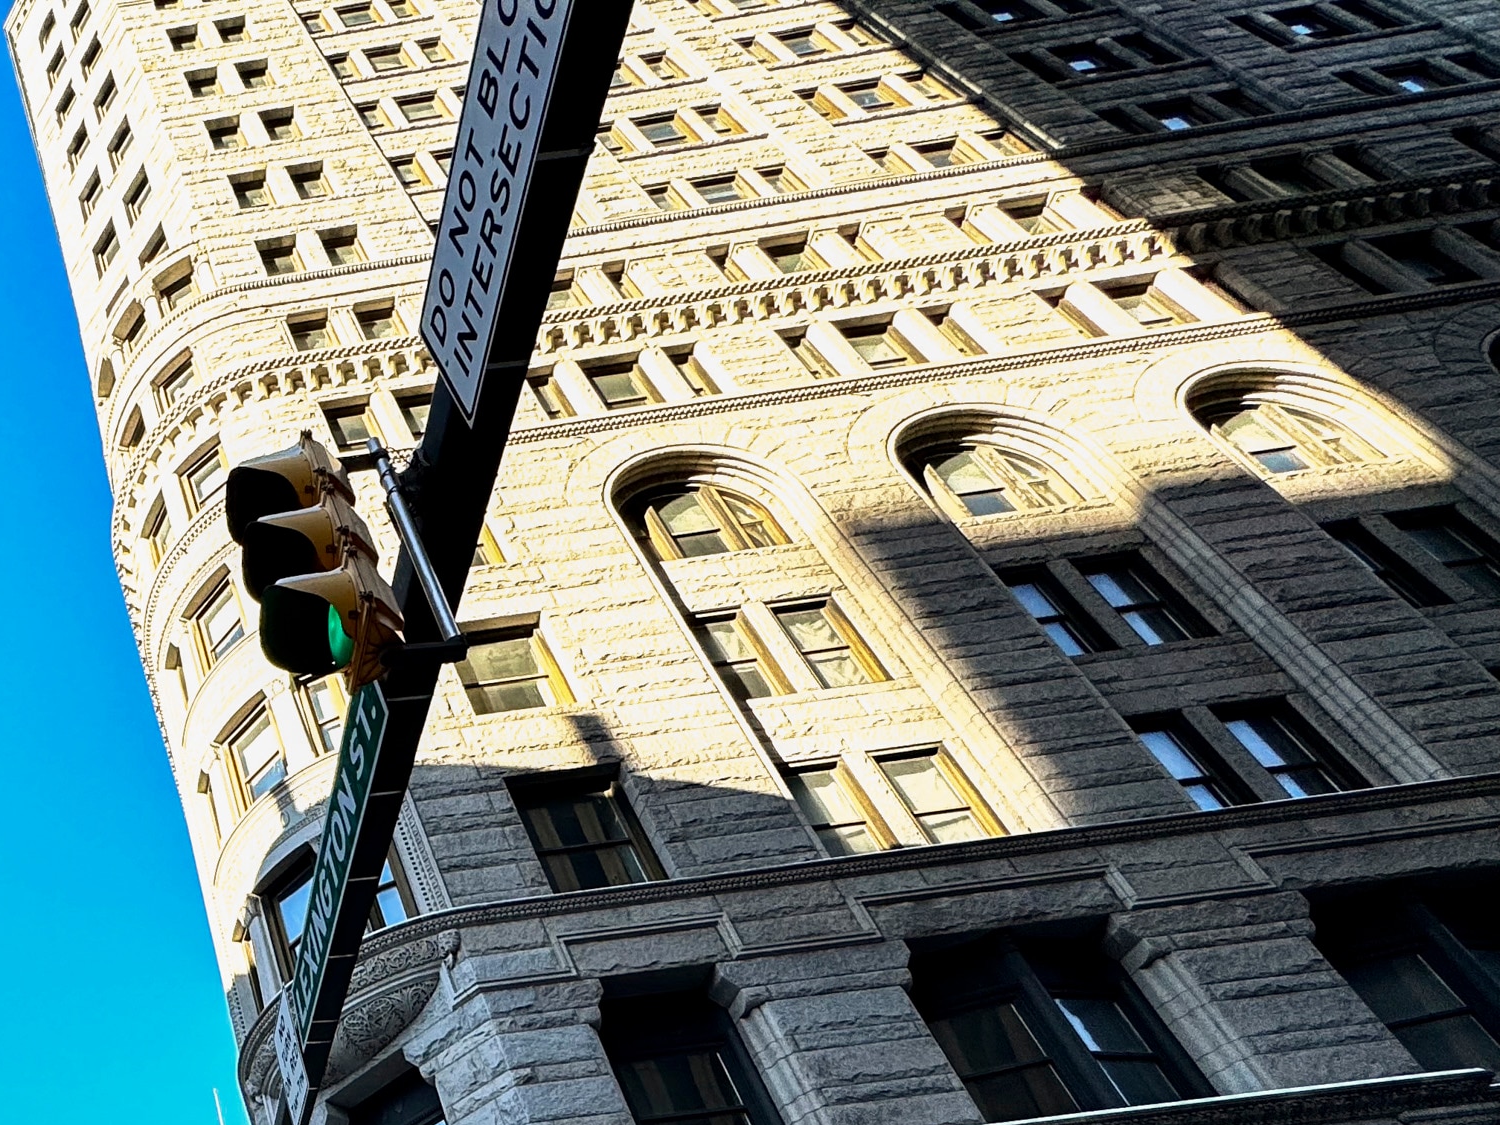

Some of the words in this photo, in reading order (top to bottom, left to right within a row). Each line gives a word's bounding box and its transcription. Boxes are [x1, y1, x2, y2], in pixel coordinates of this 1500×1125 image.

[430, 268, 455, 347] DO
[449, 128, 485, 257] NOT
[298, 768, 357, 1029] LEXINGTON
[349, 691, 377, 778] ST.
